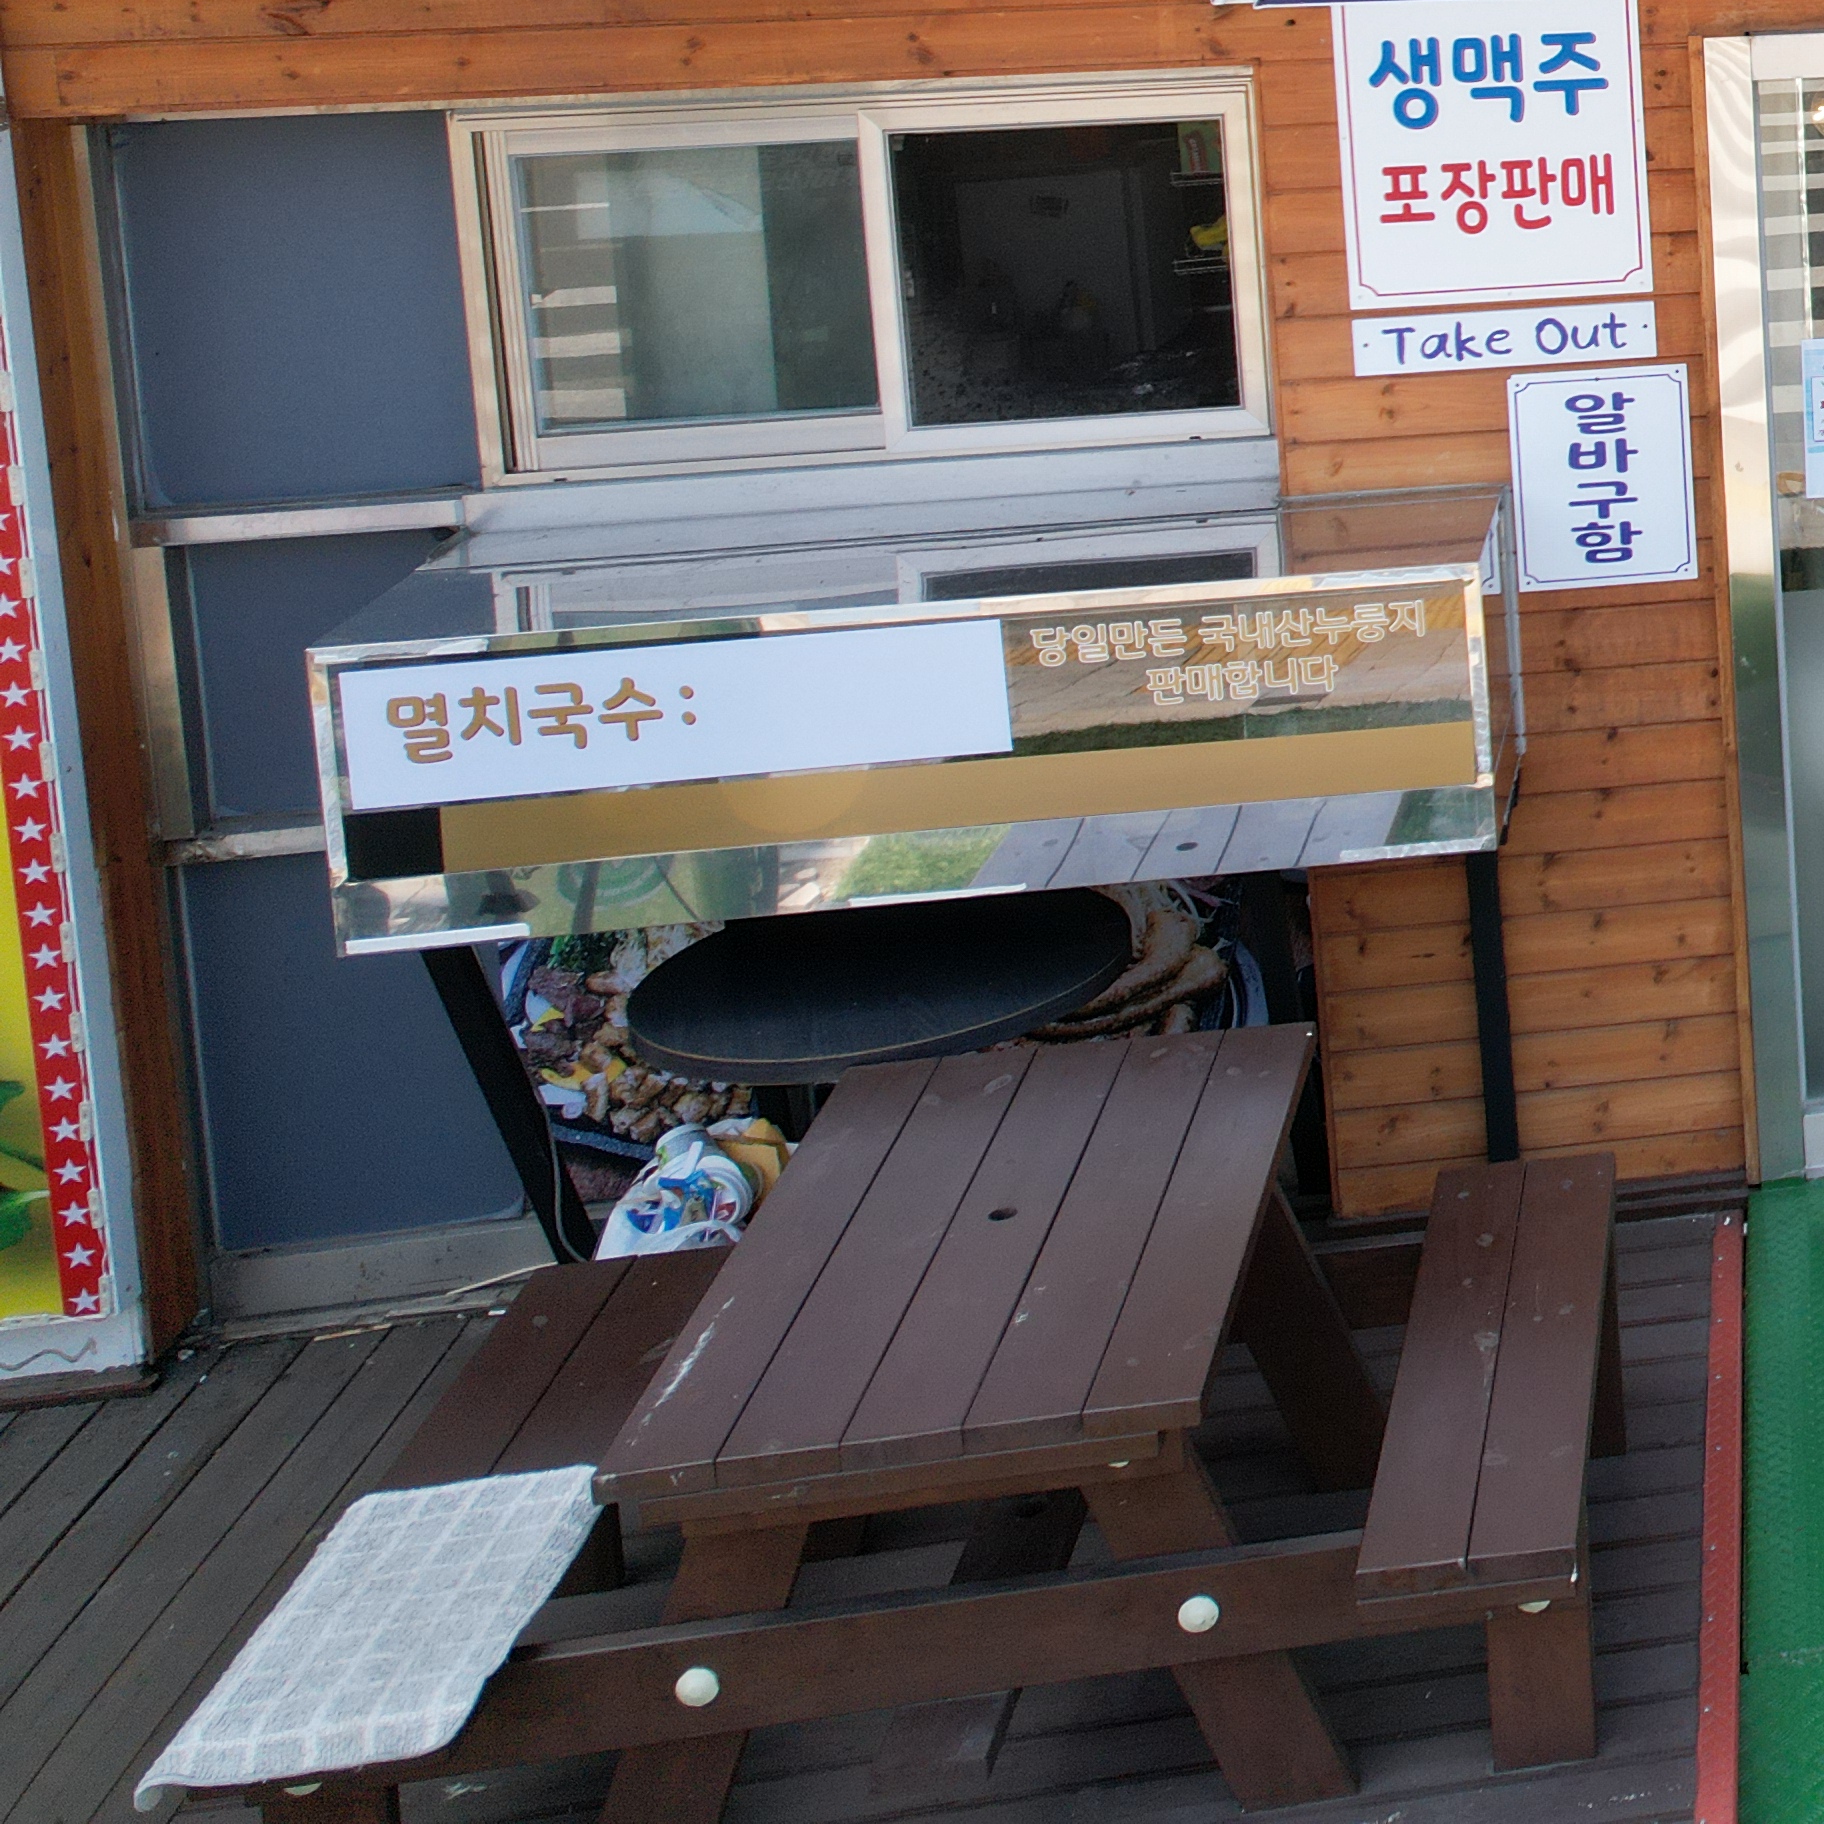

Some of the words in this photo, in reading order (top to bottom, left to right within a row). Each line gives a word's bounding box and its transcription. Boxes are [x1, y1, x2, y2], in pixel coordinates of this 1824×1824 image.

[1368, 32, 1609, 129] 생맥주
[1380, 152, 1615, 235] 포장판매
[1381, 321, 1513, 364] Take
[1535, 312, 1628, 356] Out
[1030, 618, 1187, 667] 당일만든
[1198, 600, 1426, 651] 국내산누룽지
[1145, 655, 1338, 706] 판매합니다
